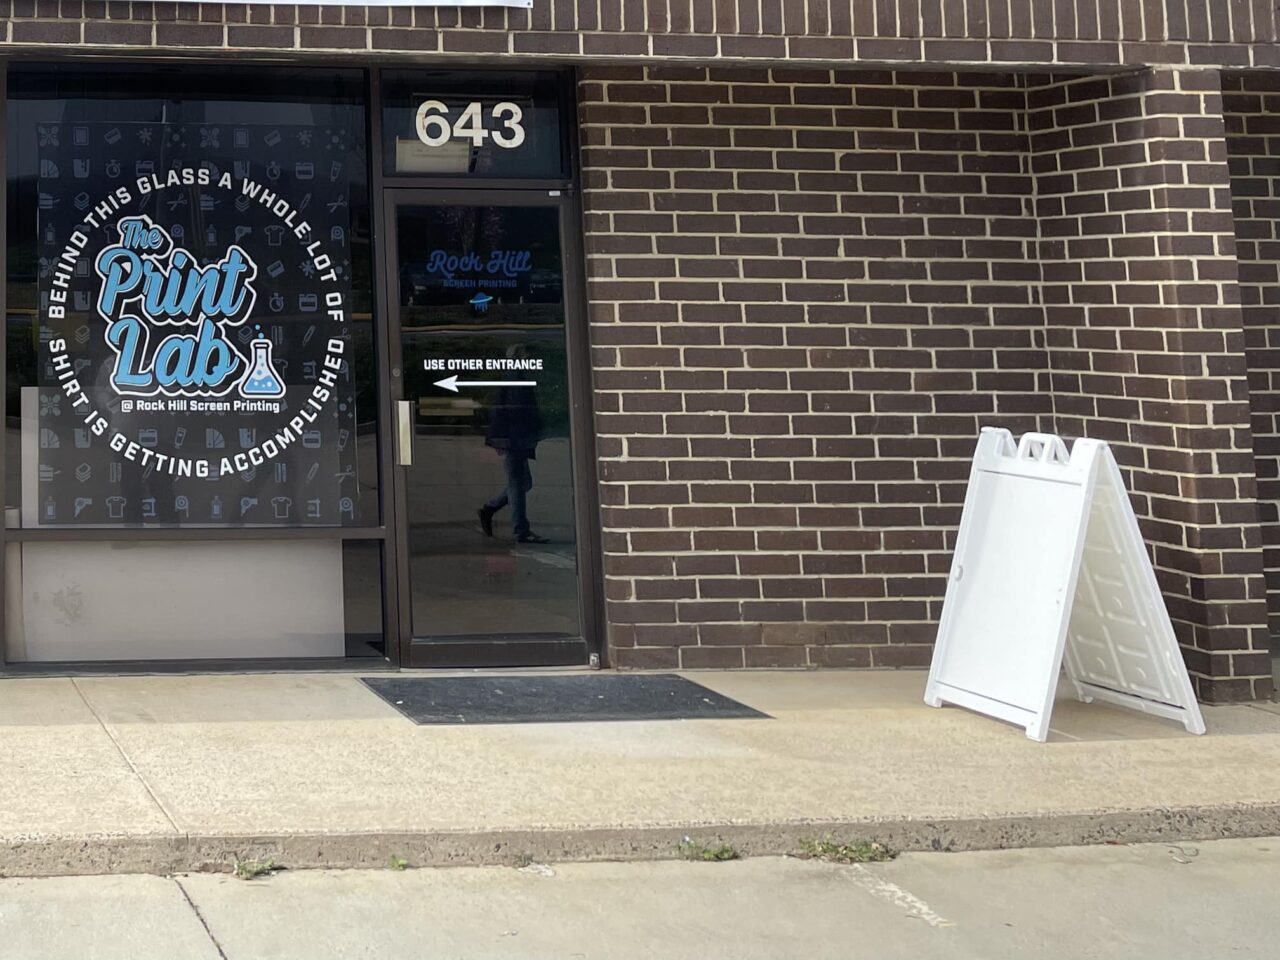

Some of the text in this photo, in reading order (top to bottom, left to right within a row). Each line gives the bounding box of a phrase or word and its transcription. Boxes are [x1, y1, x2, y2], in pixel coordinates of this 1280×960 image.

[415, 100, 525, 149] 643
[49, 168, 343, 321] BEHIND THIS GLASS A WHOLE LOT OF
[121, 219, 163, 250] The
[98, 247, 253, 319] Print
[426, 250, 531, 279] Rock Hill
[107, 320, 242, 388] Lab
[424, 359, 543, 370] USE OTHER ENTRANCE
[49, 338, 344, 477] SHIRT IS GETTING ACCOMPLISHED
[121, 400, 280, 413] @ Rock Hill Screen Printing
